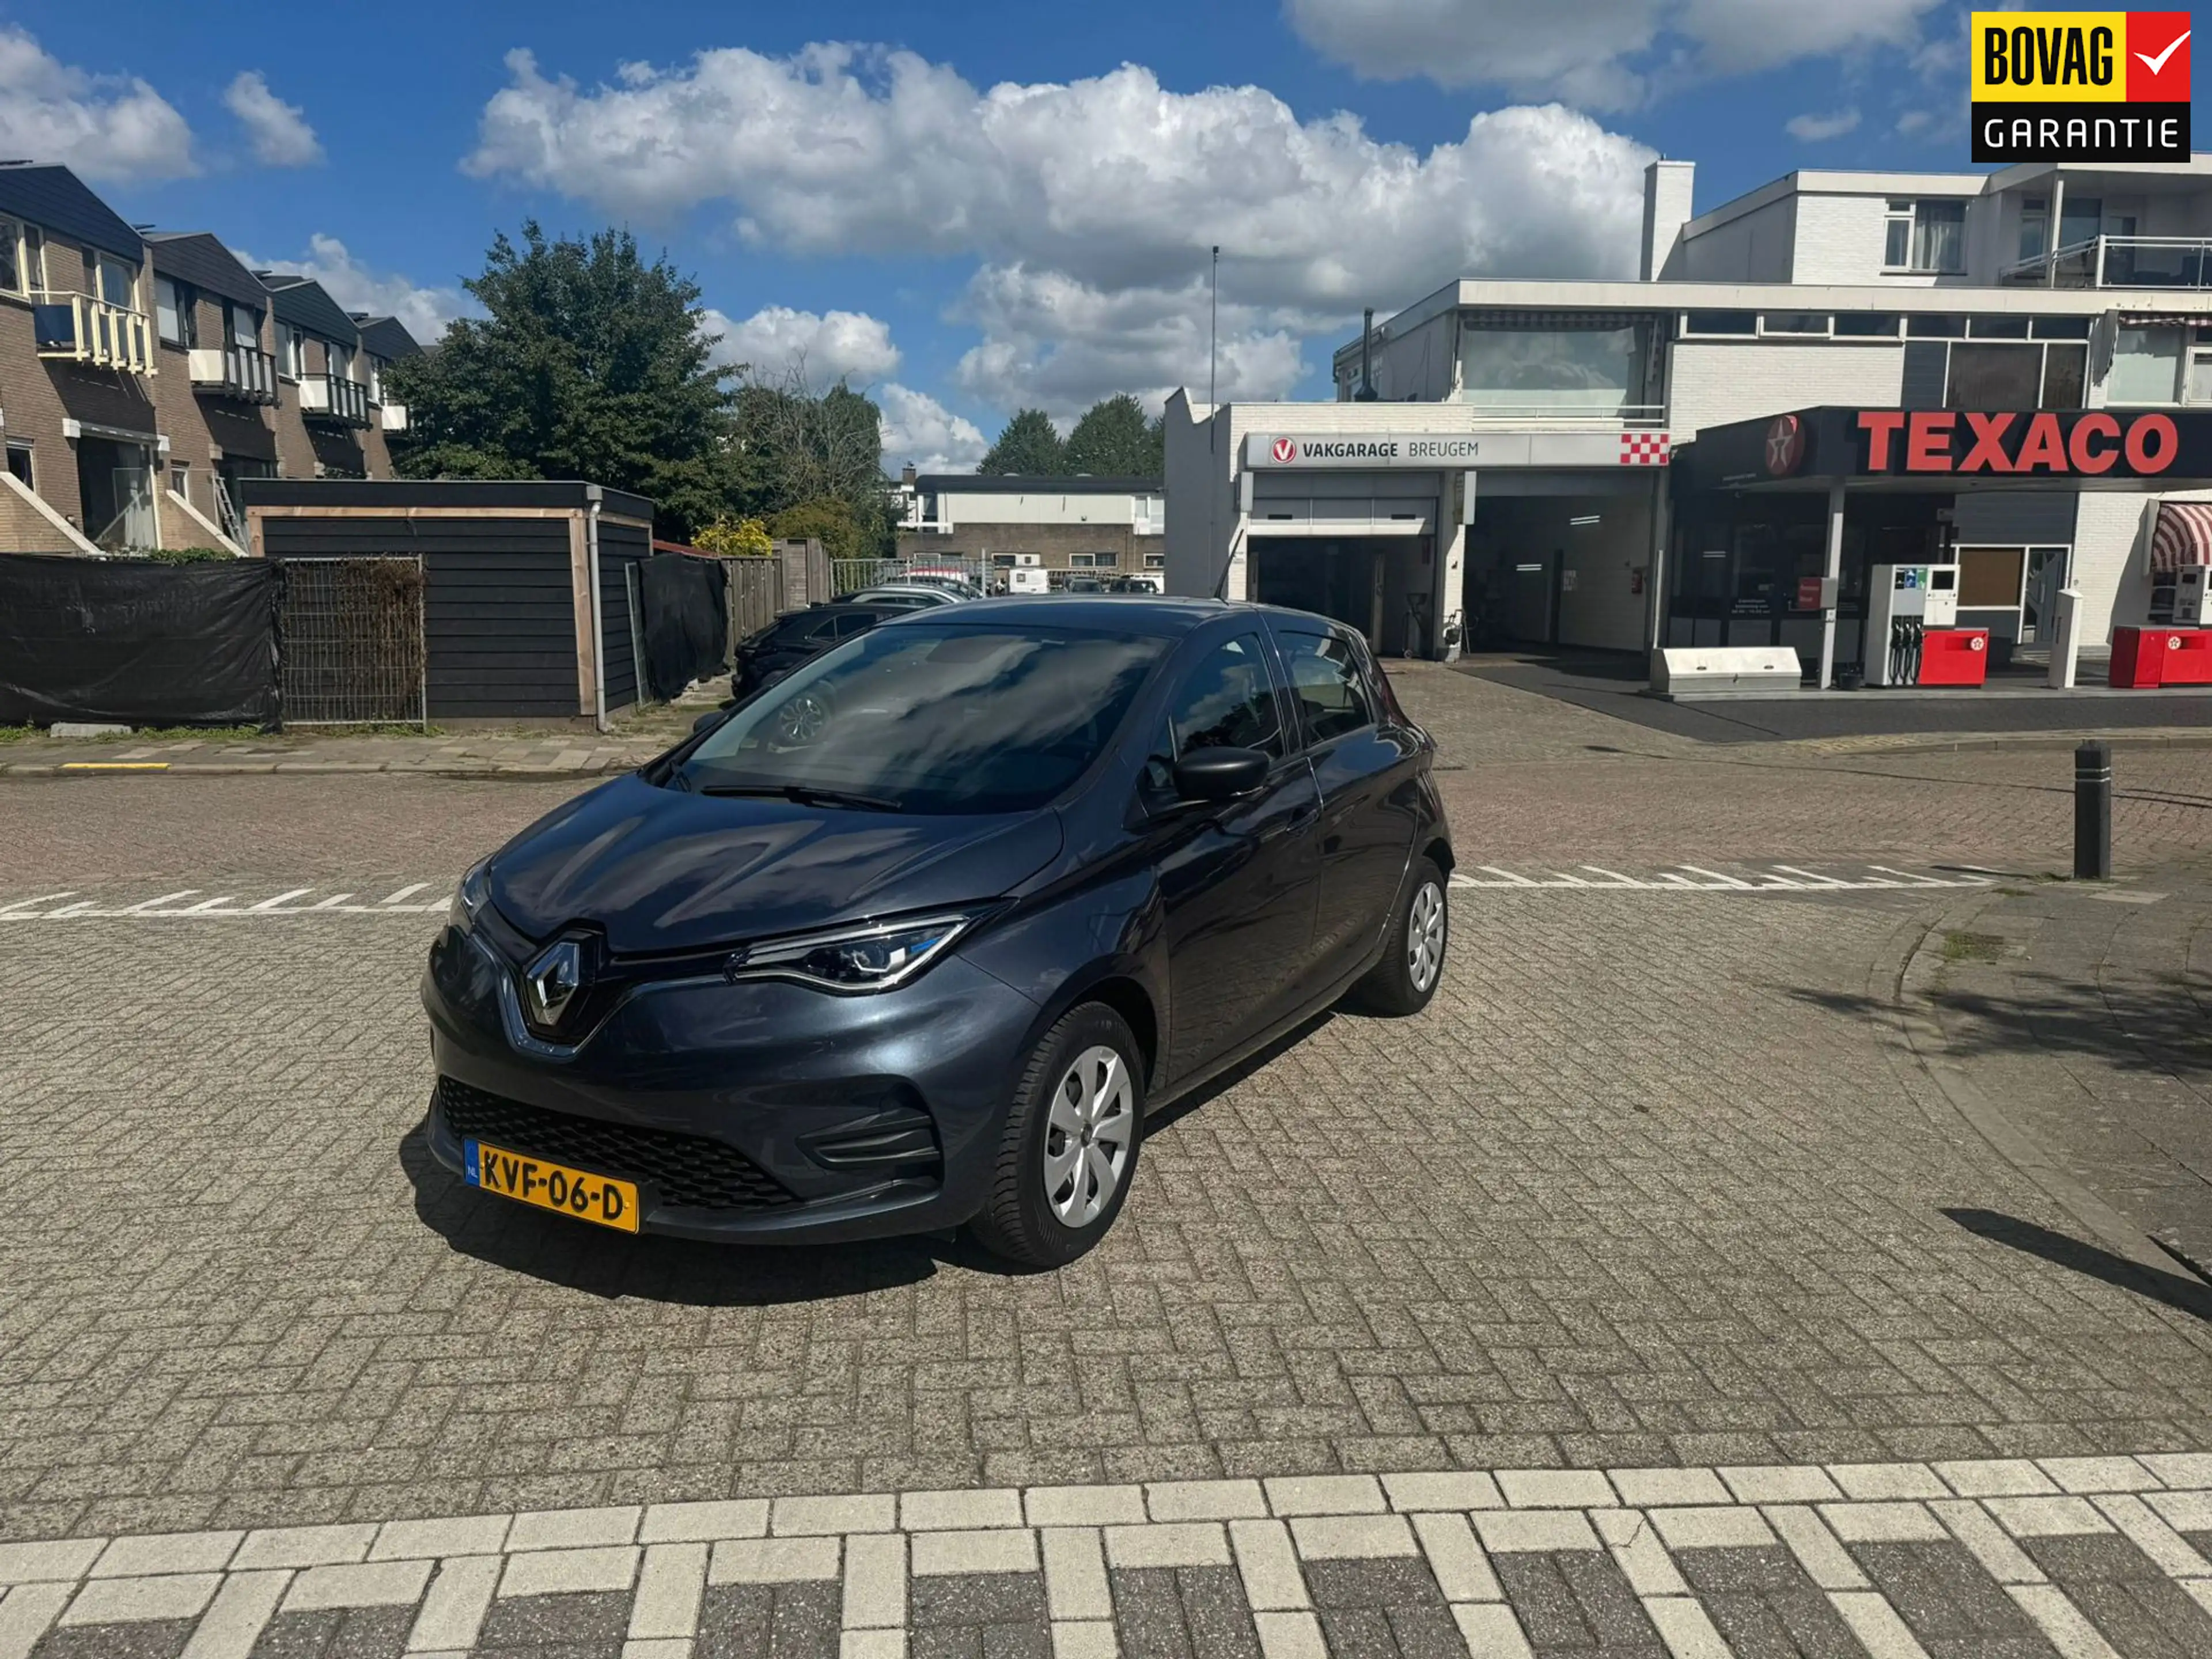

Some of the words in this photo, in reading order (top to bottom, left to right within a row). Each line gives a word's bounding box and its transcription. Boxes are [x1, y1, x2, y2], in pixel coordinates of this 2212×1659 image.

[1302, 442, 1398, 458] VAKGARAGE
[1408, 441, 1479, 457] BREUGEM
[1858, 411, 2179, 474] TEXACO
[467, 1164, 478, 1179] NL
[484, 1150, 623, 1221] KVF-06-D
